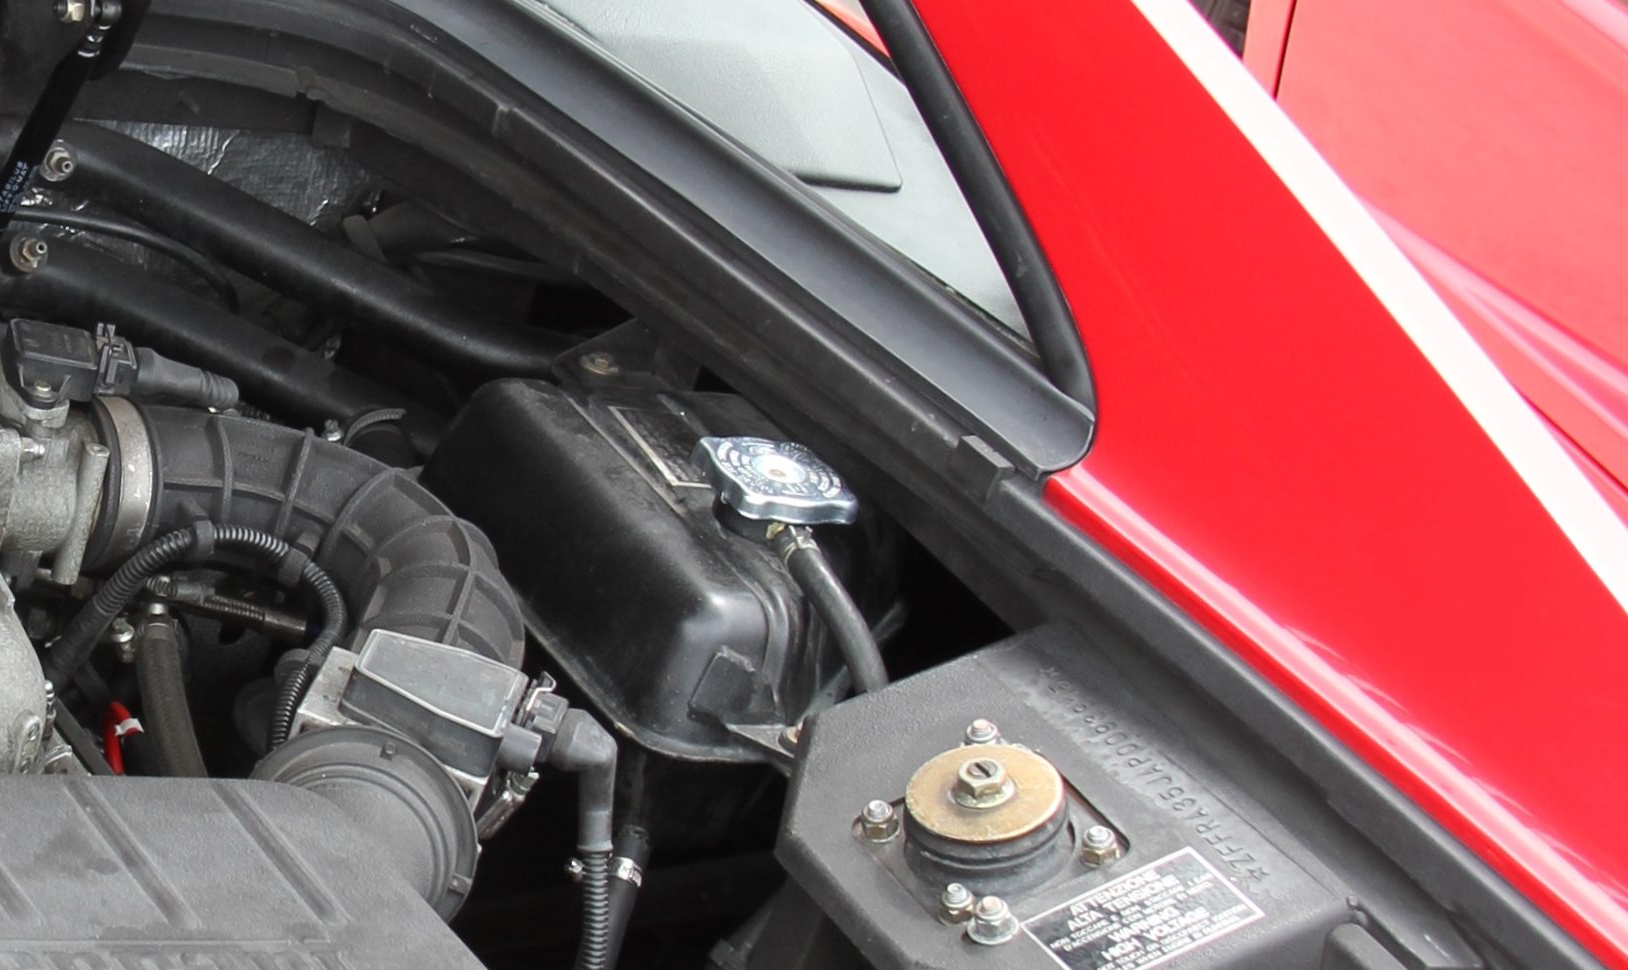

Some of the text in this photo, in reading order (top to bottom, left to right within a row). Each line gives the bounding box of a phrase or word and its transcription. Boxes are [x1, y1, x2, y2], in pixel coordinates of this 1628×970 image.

[1067, 874, 1179, 930] ALTA TENSIONE
[1071, 868, 1160, 914] ATTENZIONE
[1101, 906, 1209, 960] HIGH VOLTAGE
[1108, 906, 1179, 941] WARNING
[1115, 949, 1145, 964] TOUCH
